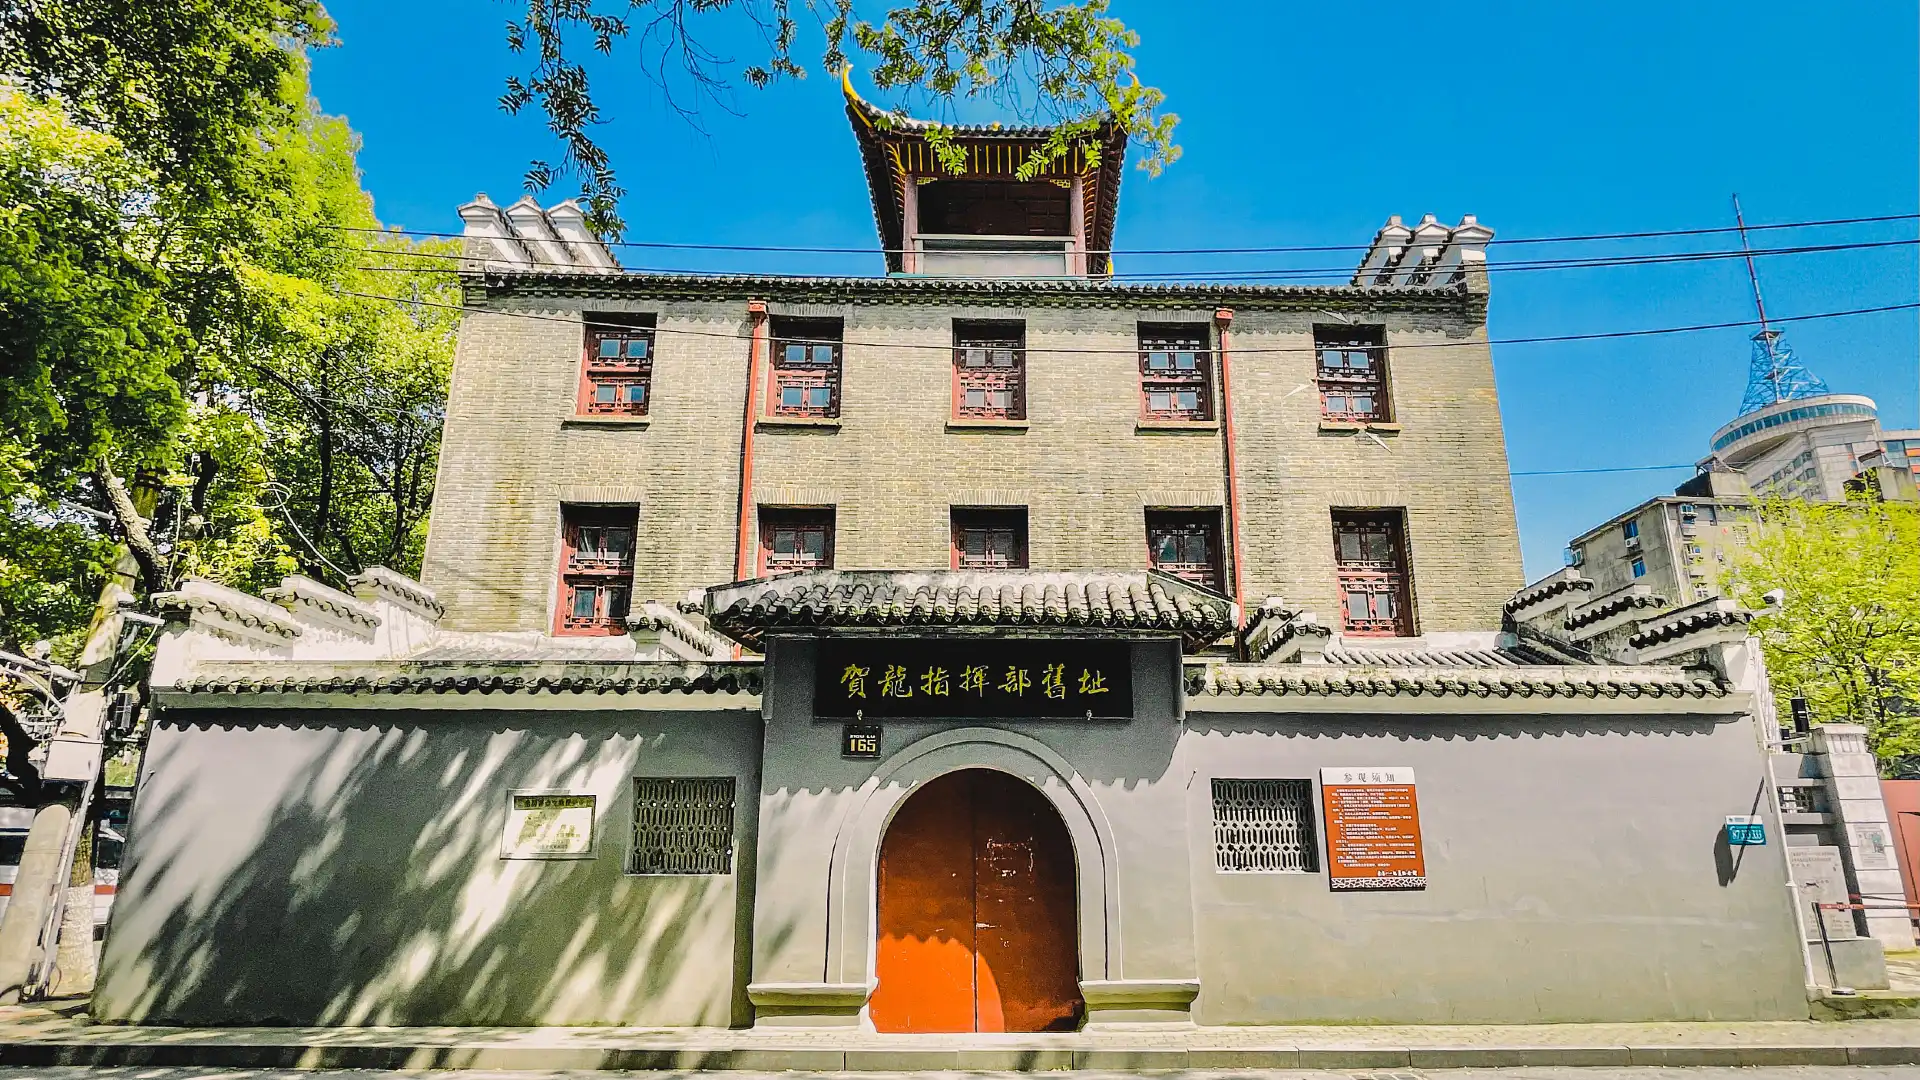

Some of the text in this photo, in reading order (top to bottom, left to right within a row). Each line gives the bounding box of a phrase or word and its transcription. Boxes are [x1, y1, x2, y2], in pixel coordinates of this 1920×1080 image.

[840, 662, 1110, 699] 賀龍指揮部舊址
[850, 739, 876, 752] 165
[1343, 772, 1395, 783] 参观须知
